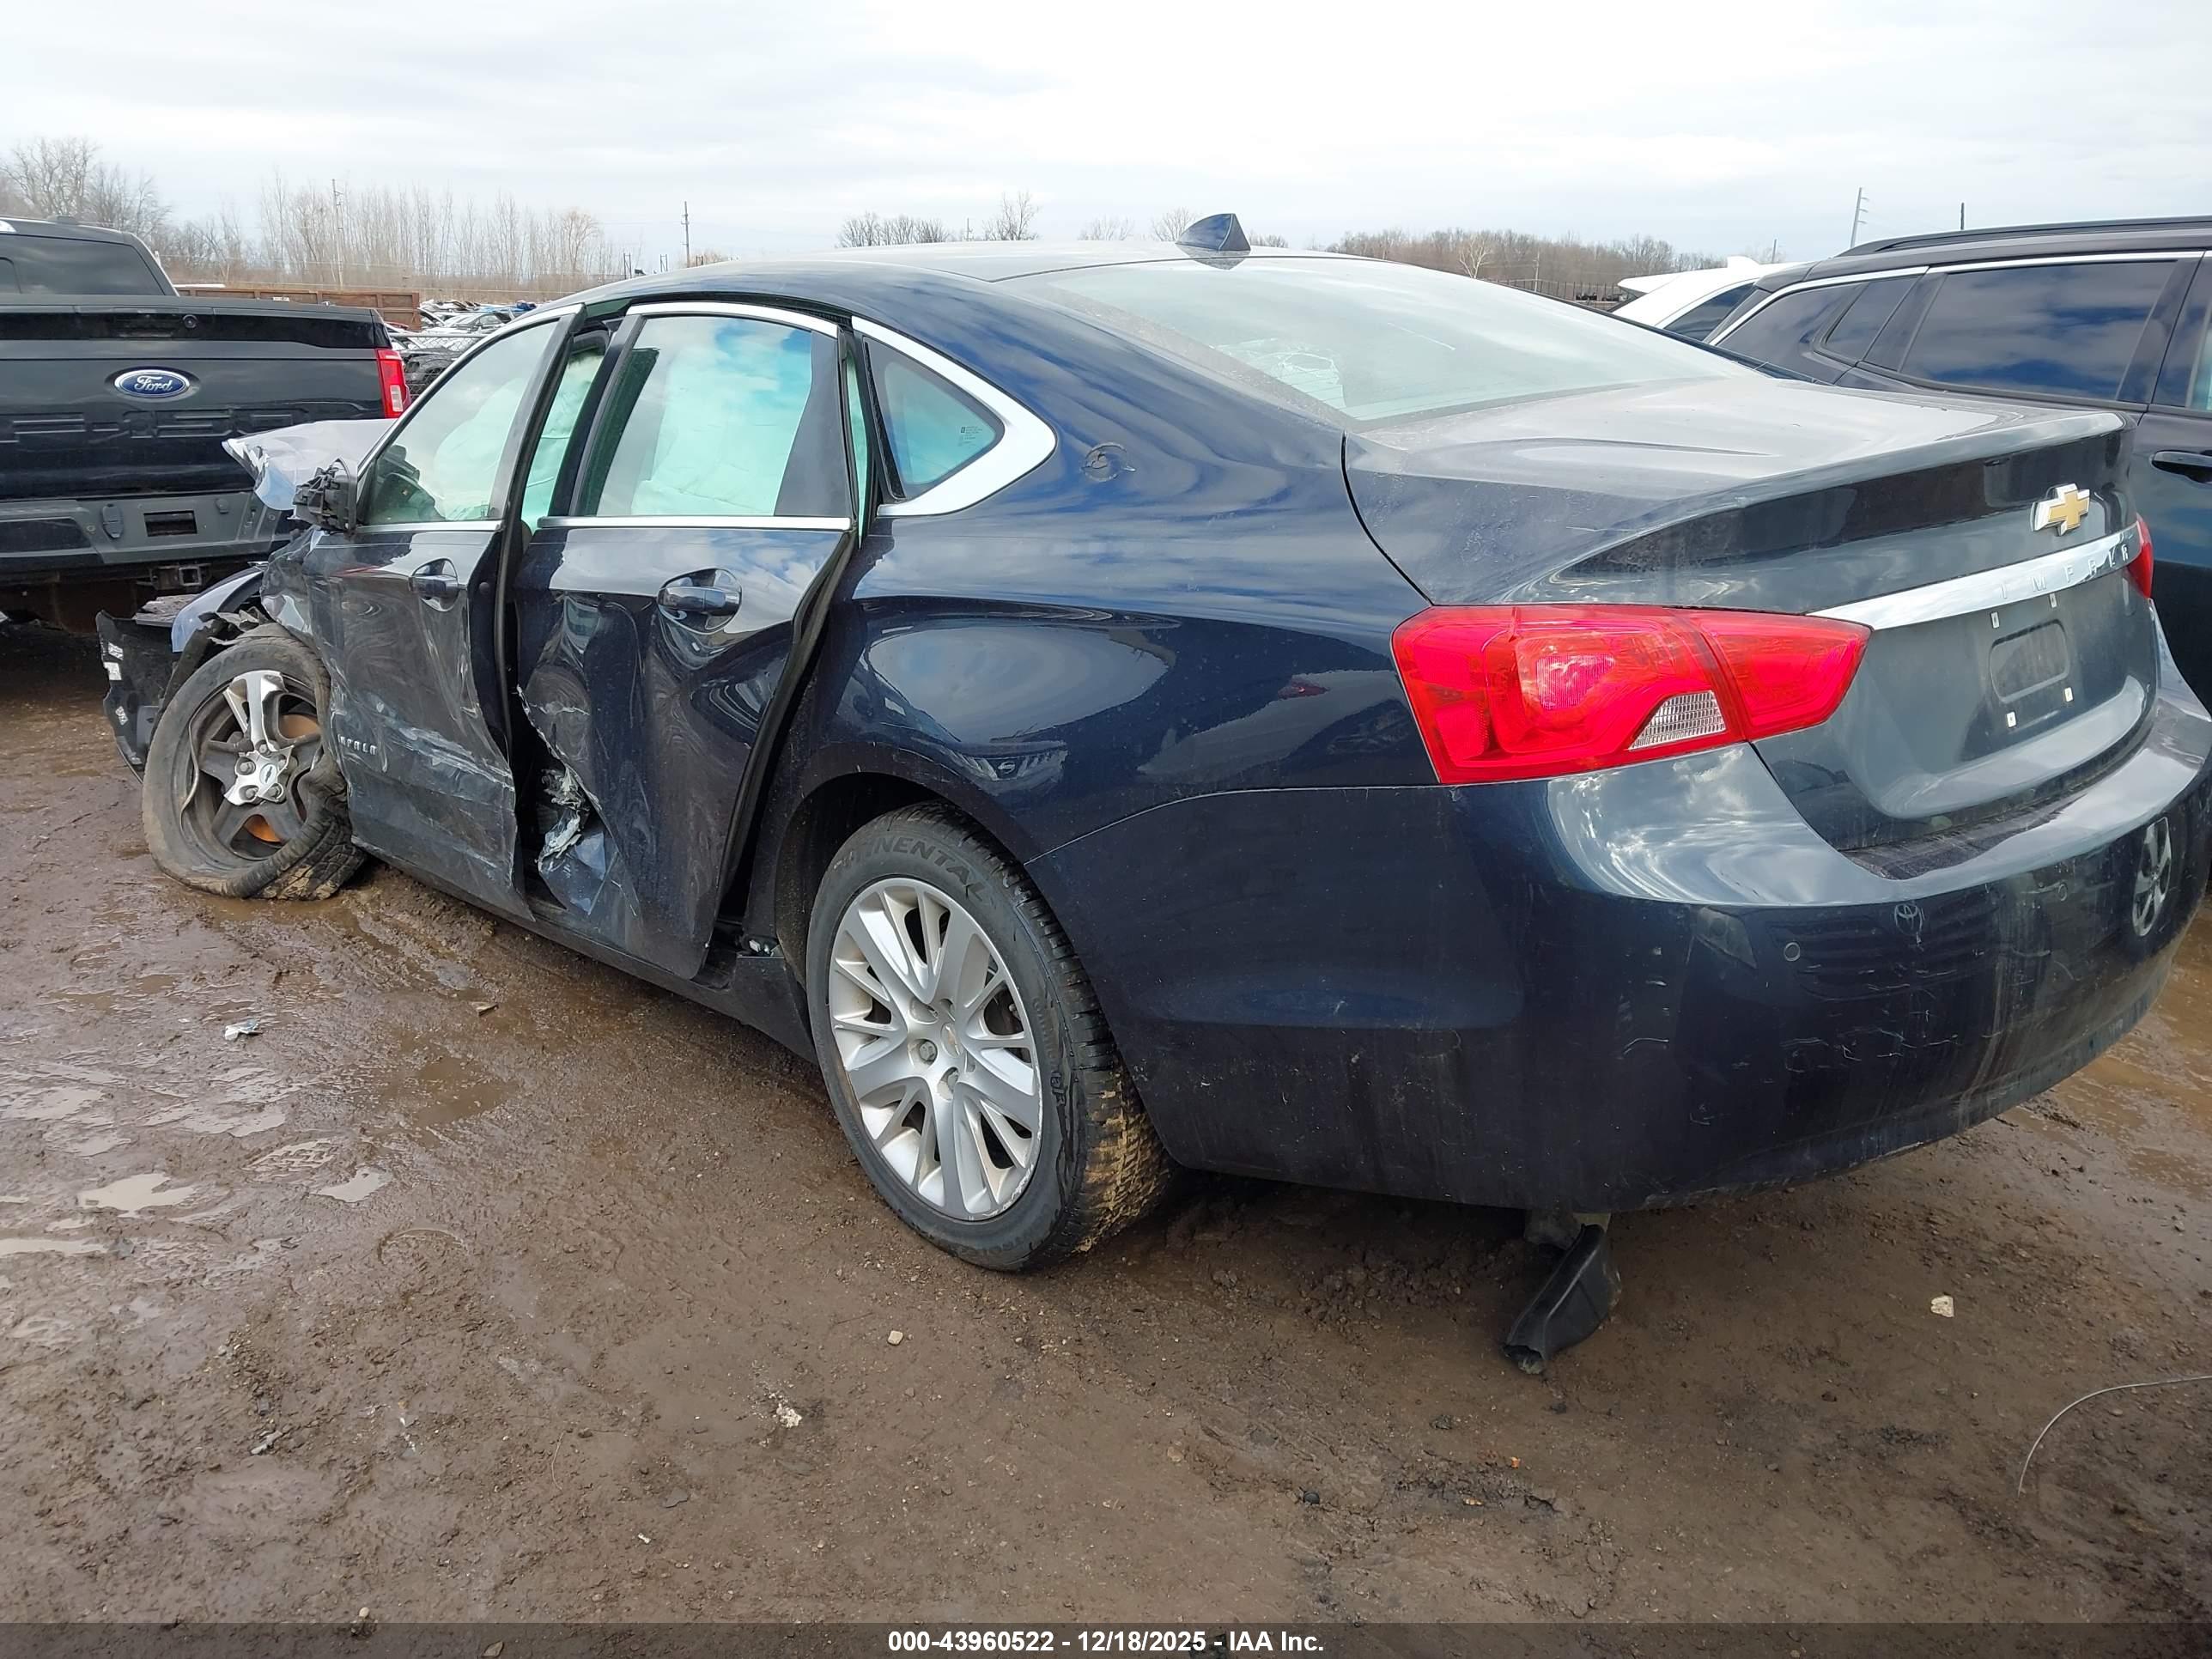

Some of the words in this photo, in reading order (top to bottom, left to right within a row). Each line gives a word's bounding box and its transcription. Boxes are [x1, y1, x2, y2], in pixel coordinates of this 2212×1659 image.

[134, 375, 173, 392] Ford
[1999, 544, 2129, 599] IMPALA
[850, 836, 987, 902] INENTAL
